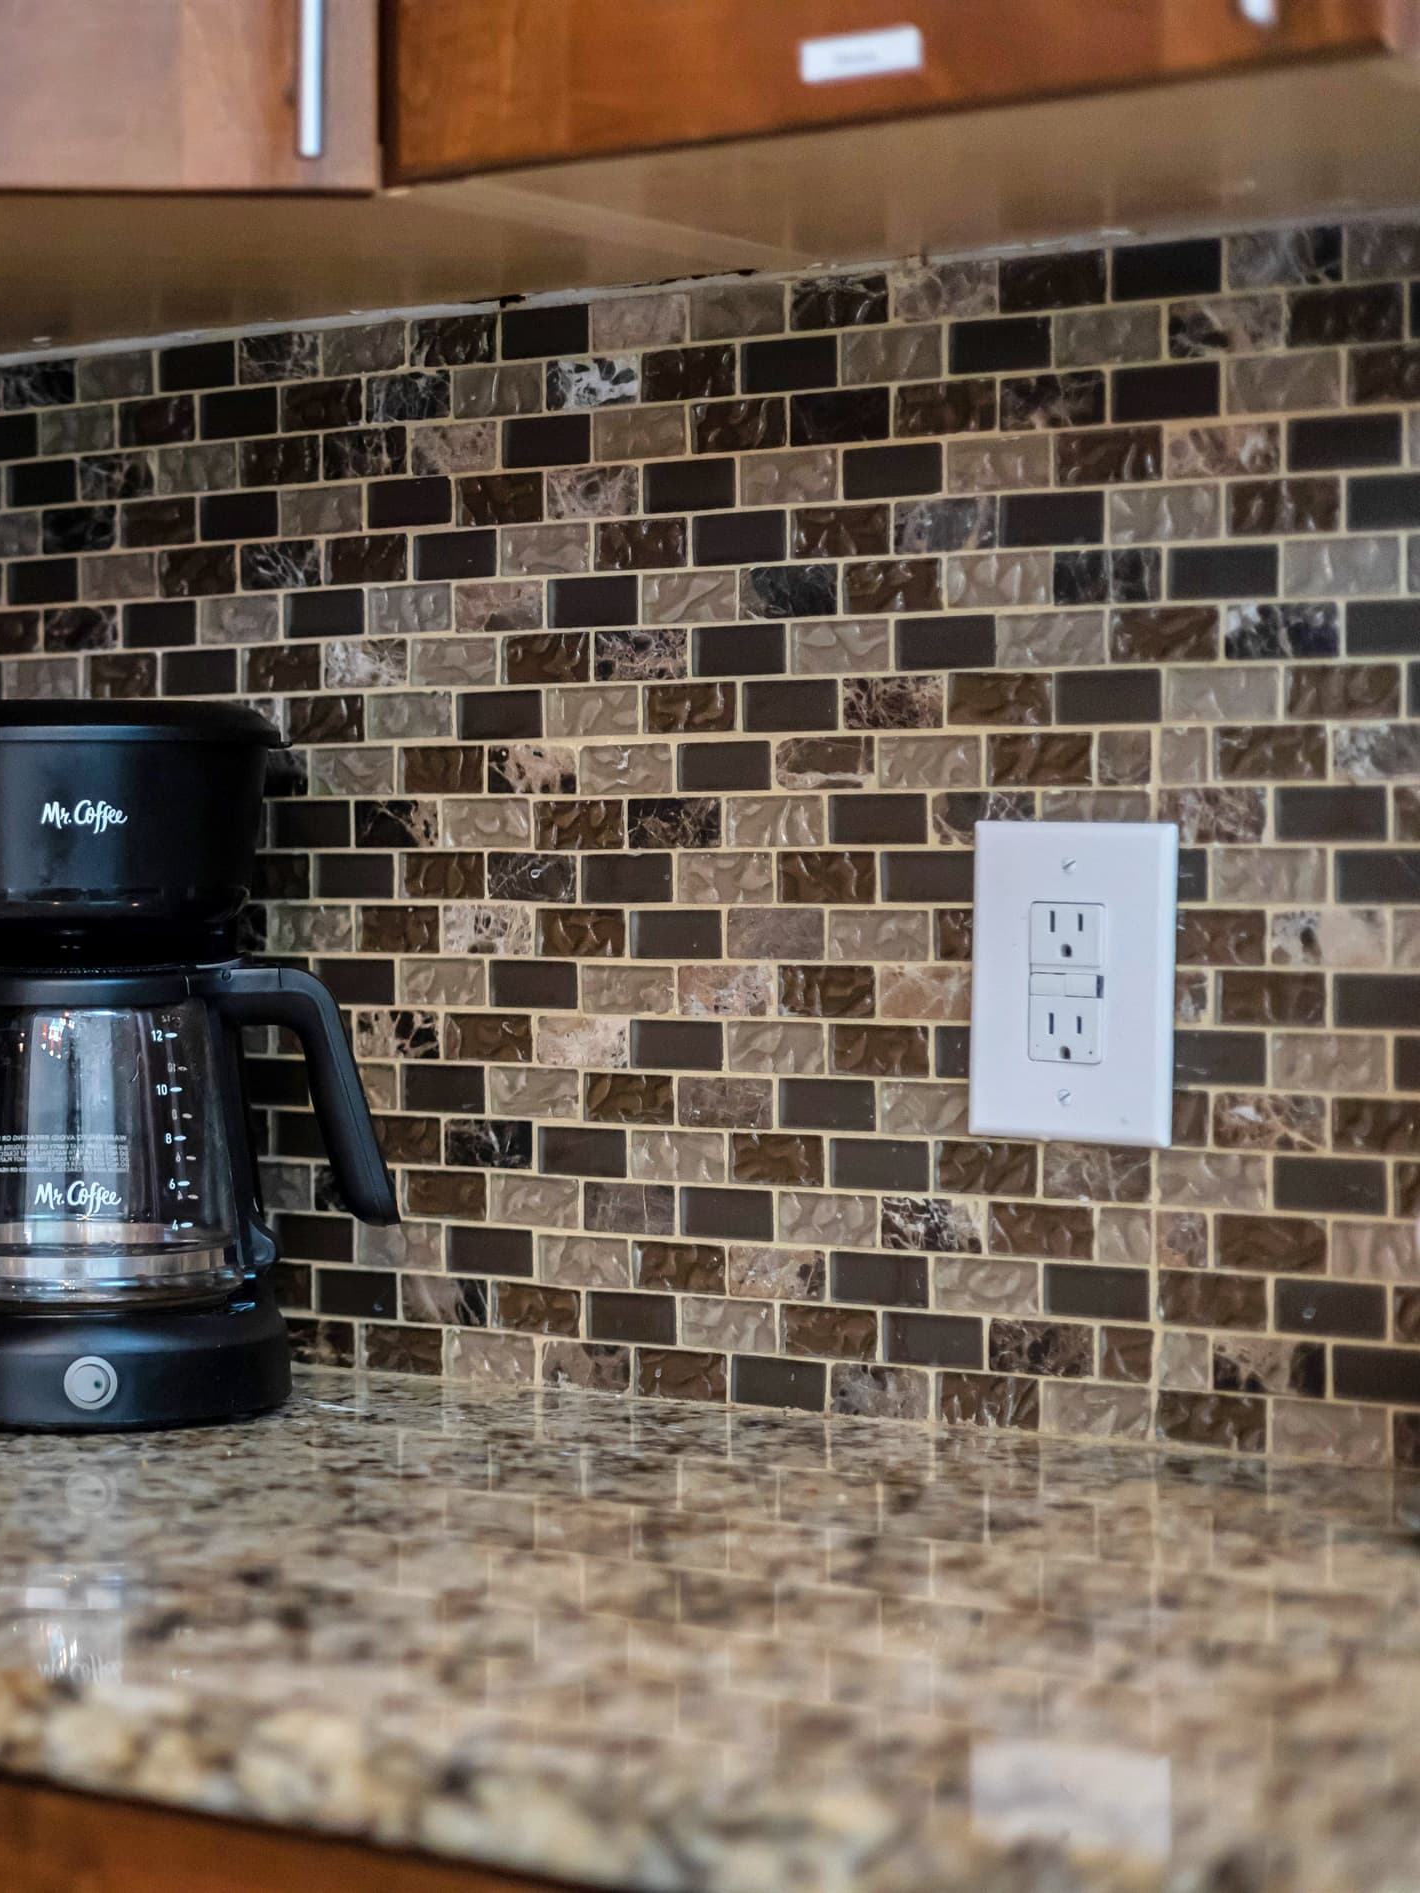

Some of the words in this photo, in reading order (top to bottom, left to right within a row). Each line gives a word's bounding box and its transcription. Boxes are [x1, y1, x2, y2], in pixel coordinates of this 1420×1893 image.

[41, 801, 72, 829] Mr.
[74, 799, 128, 834] Coffee
[151, 1030, 163, 1042] 12
[156, 1084, 167, 1095] 10
[165, 1132, 172, 1144] 8
[169, 1178, 176, 1189] 6
[34, 1182, 65, 1210] Mr.
[67, 1181, 122, 1217] Coffee
[172, 1218, 179, 1231] 4
